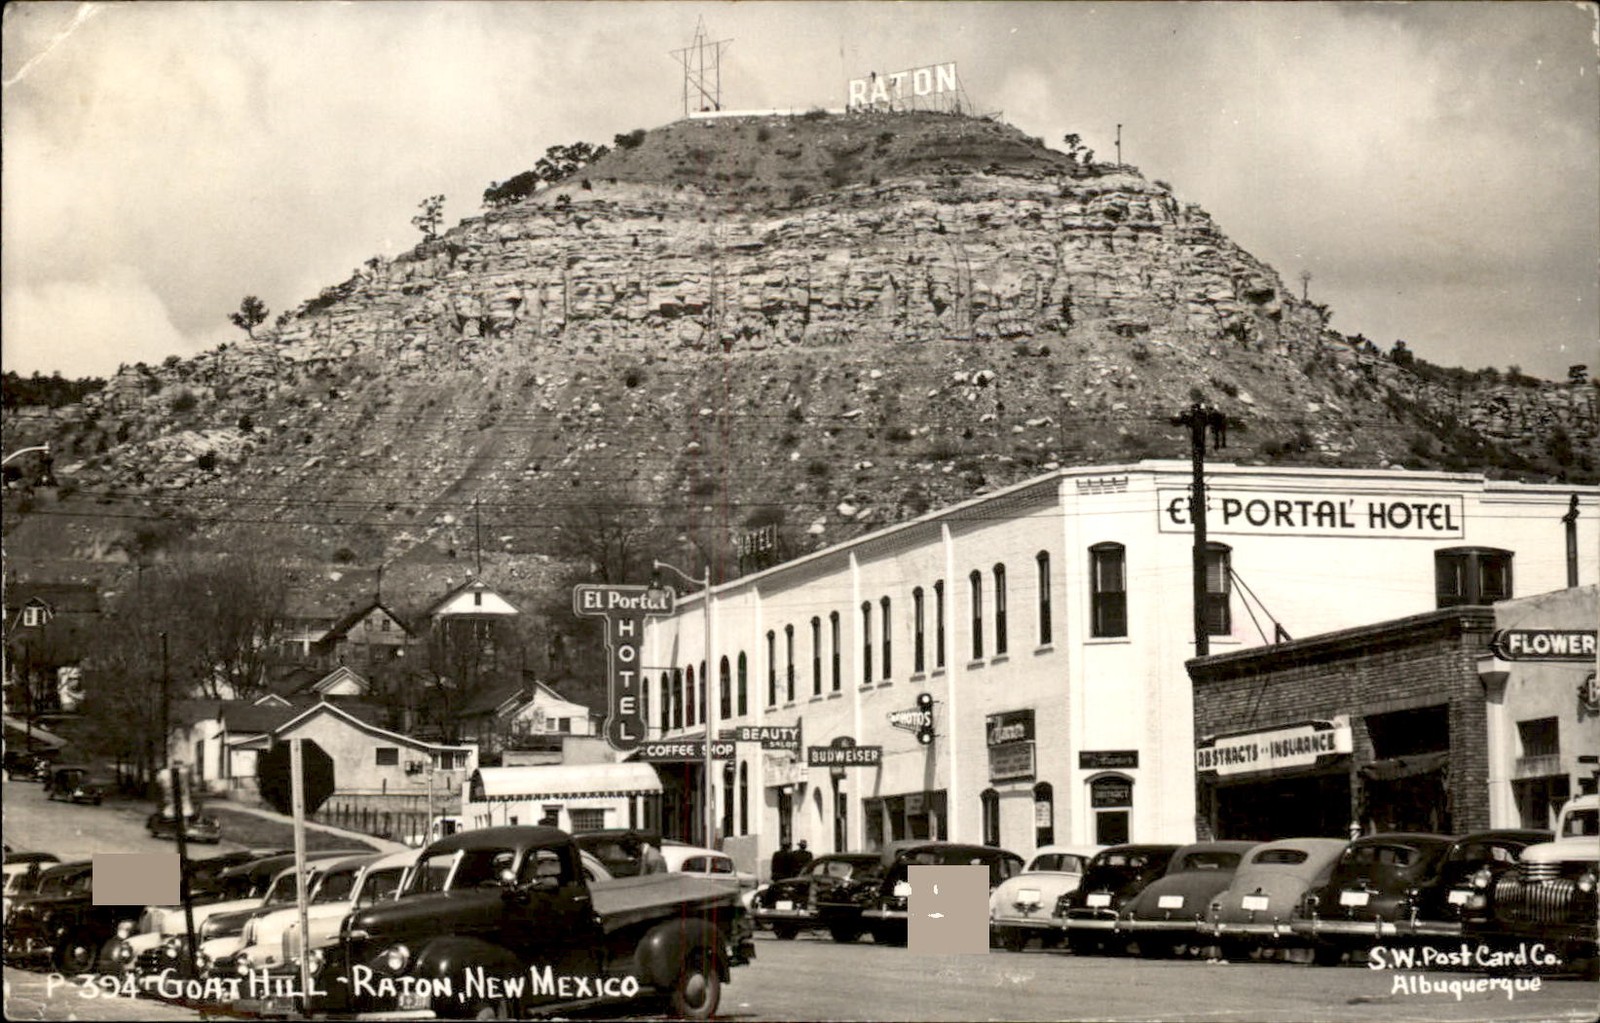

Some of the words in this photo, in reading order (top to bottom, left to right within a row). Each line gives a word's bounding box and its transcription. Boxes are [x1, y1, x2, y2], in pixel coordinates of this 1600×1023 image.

[849, 63, 956, 106] RATON
[1368, 502, 1459, 531] HOTEL
[584, 590, 604, 609] El
[618, 619, 636, 741] HOTEL
[742, 728, 799, 740] BEAUTY
[647, 743, 695, 757] COFFEE
[811, 749, 879, 763] BUDWEISER
[1198, 743, 1259, 769] ABSTRACTS
[1270, 732, 1336, 759] INSURANCE
